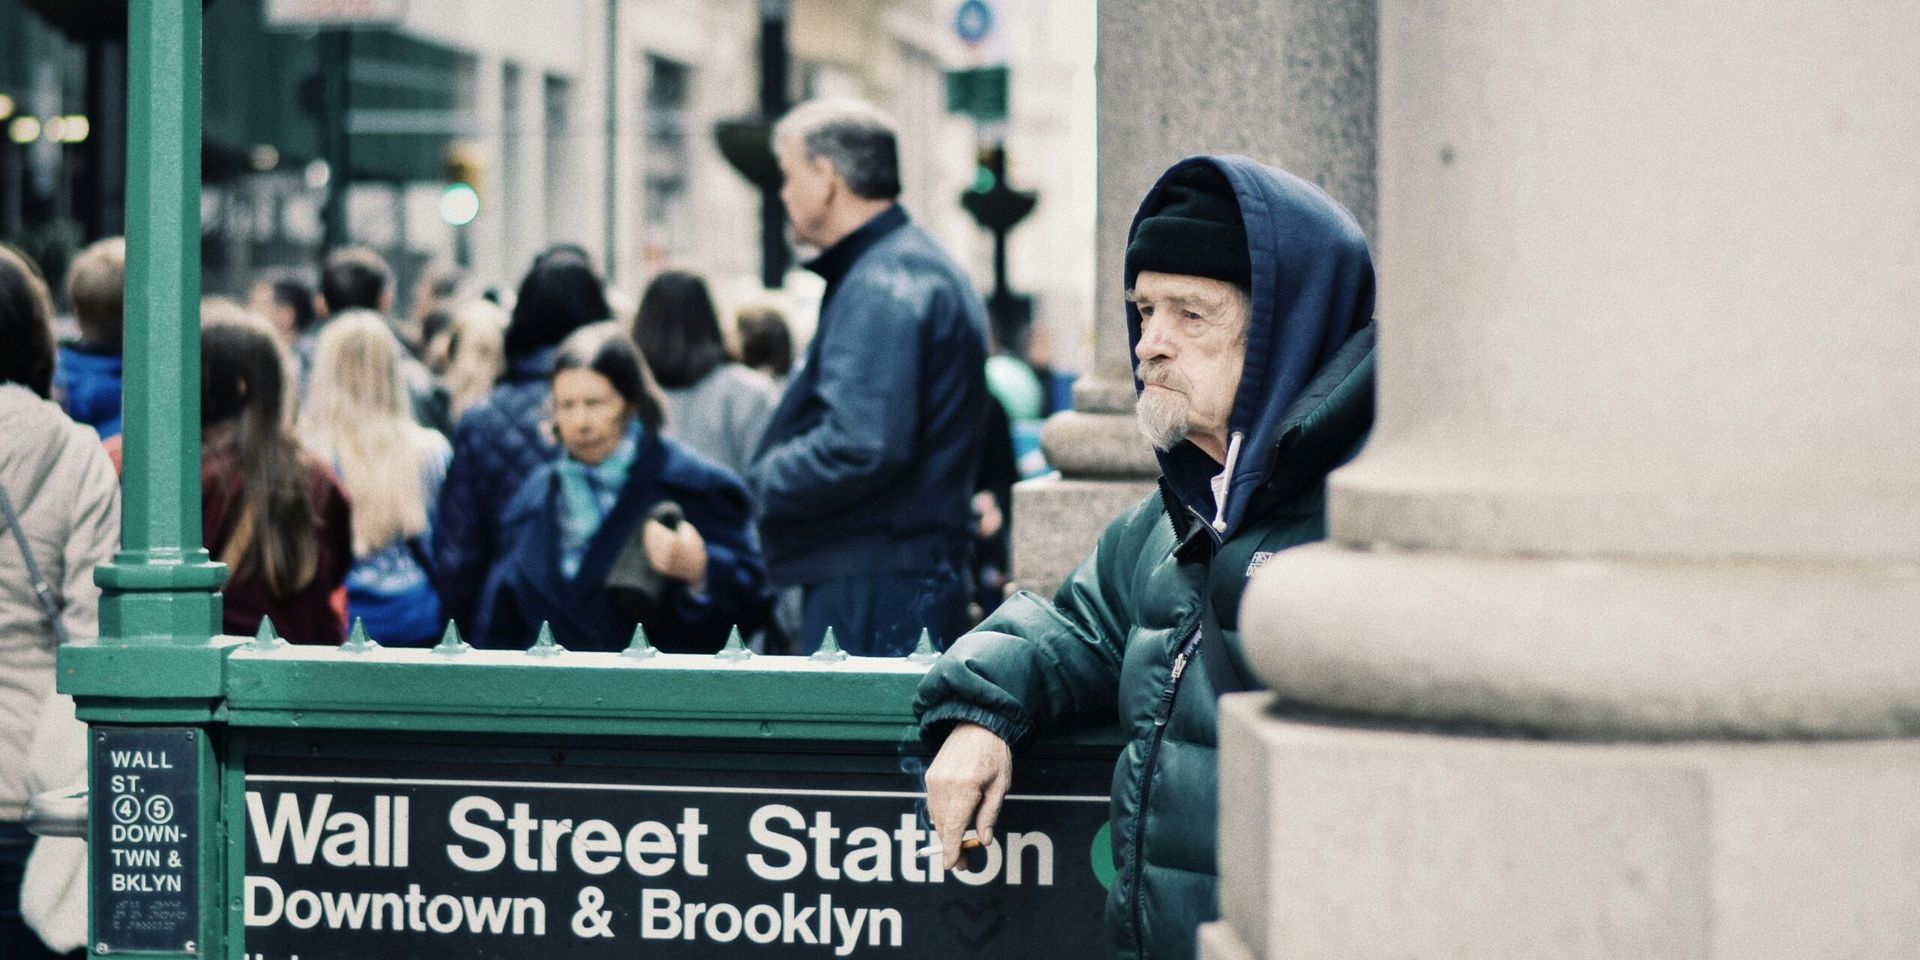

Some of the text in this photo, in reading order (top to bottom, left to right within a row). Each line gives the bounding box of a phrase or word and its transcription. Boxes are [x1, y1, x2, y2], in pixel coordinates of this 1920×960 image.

[111, 751, 173, 768] WALL
[111, 775, 144, 793] ST.
[111, 824, 187, 842] DOWN-
[246, 791, 409, 867] Wall
[446, 795, 709, 877] Street
[111, 849, 182, 867] TWN &
[111, 873, 181, 892] BKLYN
[244, 875, 545, 935] Downtown
[570, 886, 615, 938] &
[641, 888, 902, 956] Brooklyn
